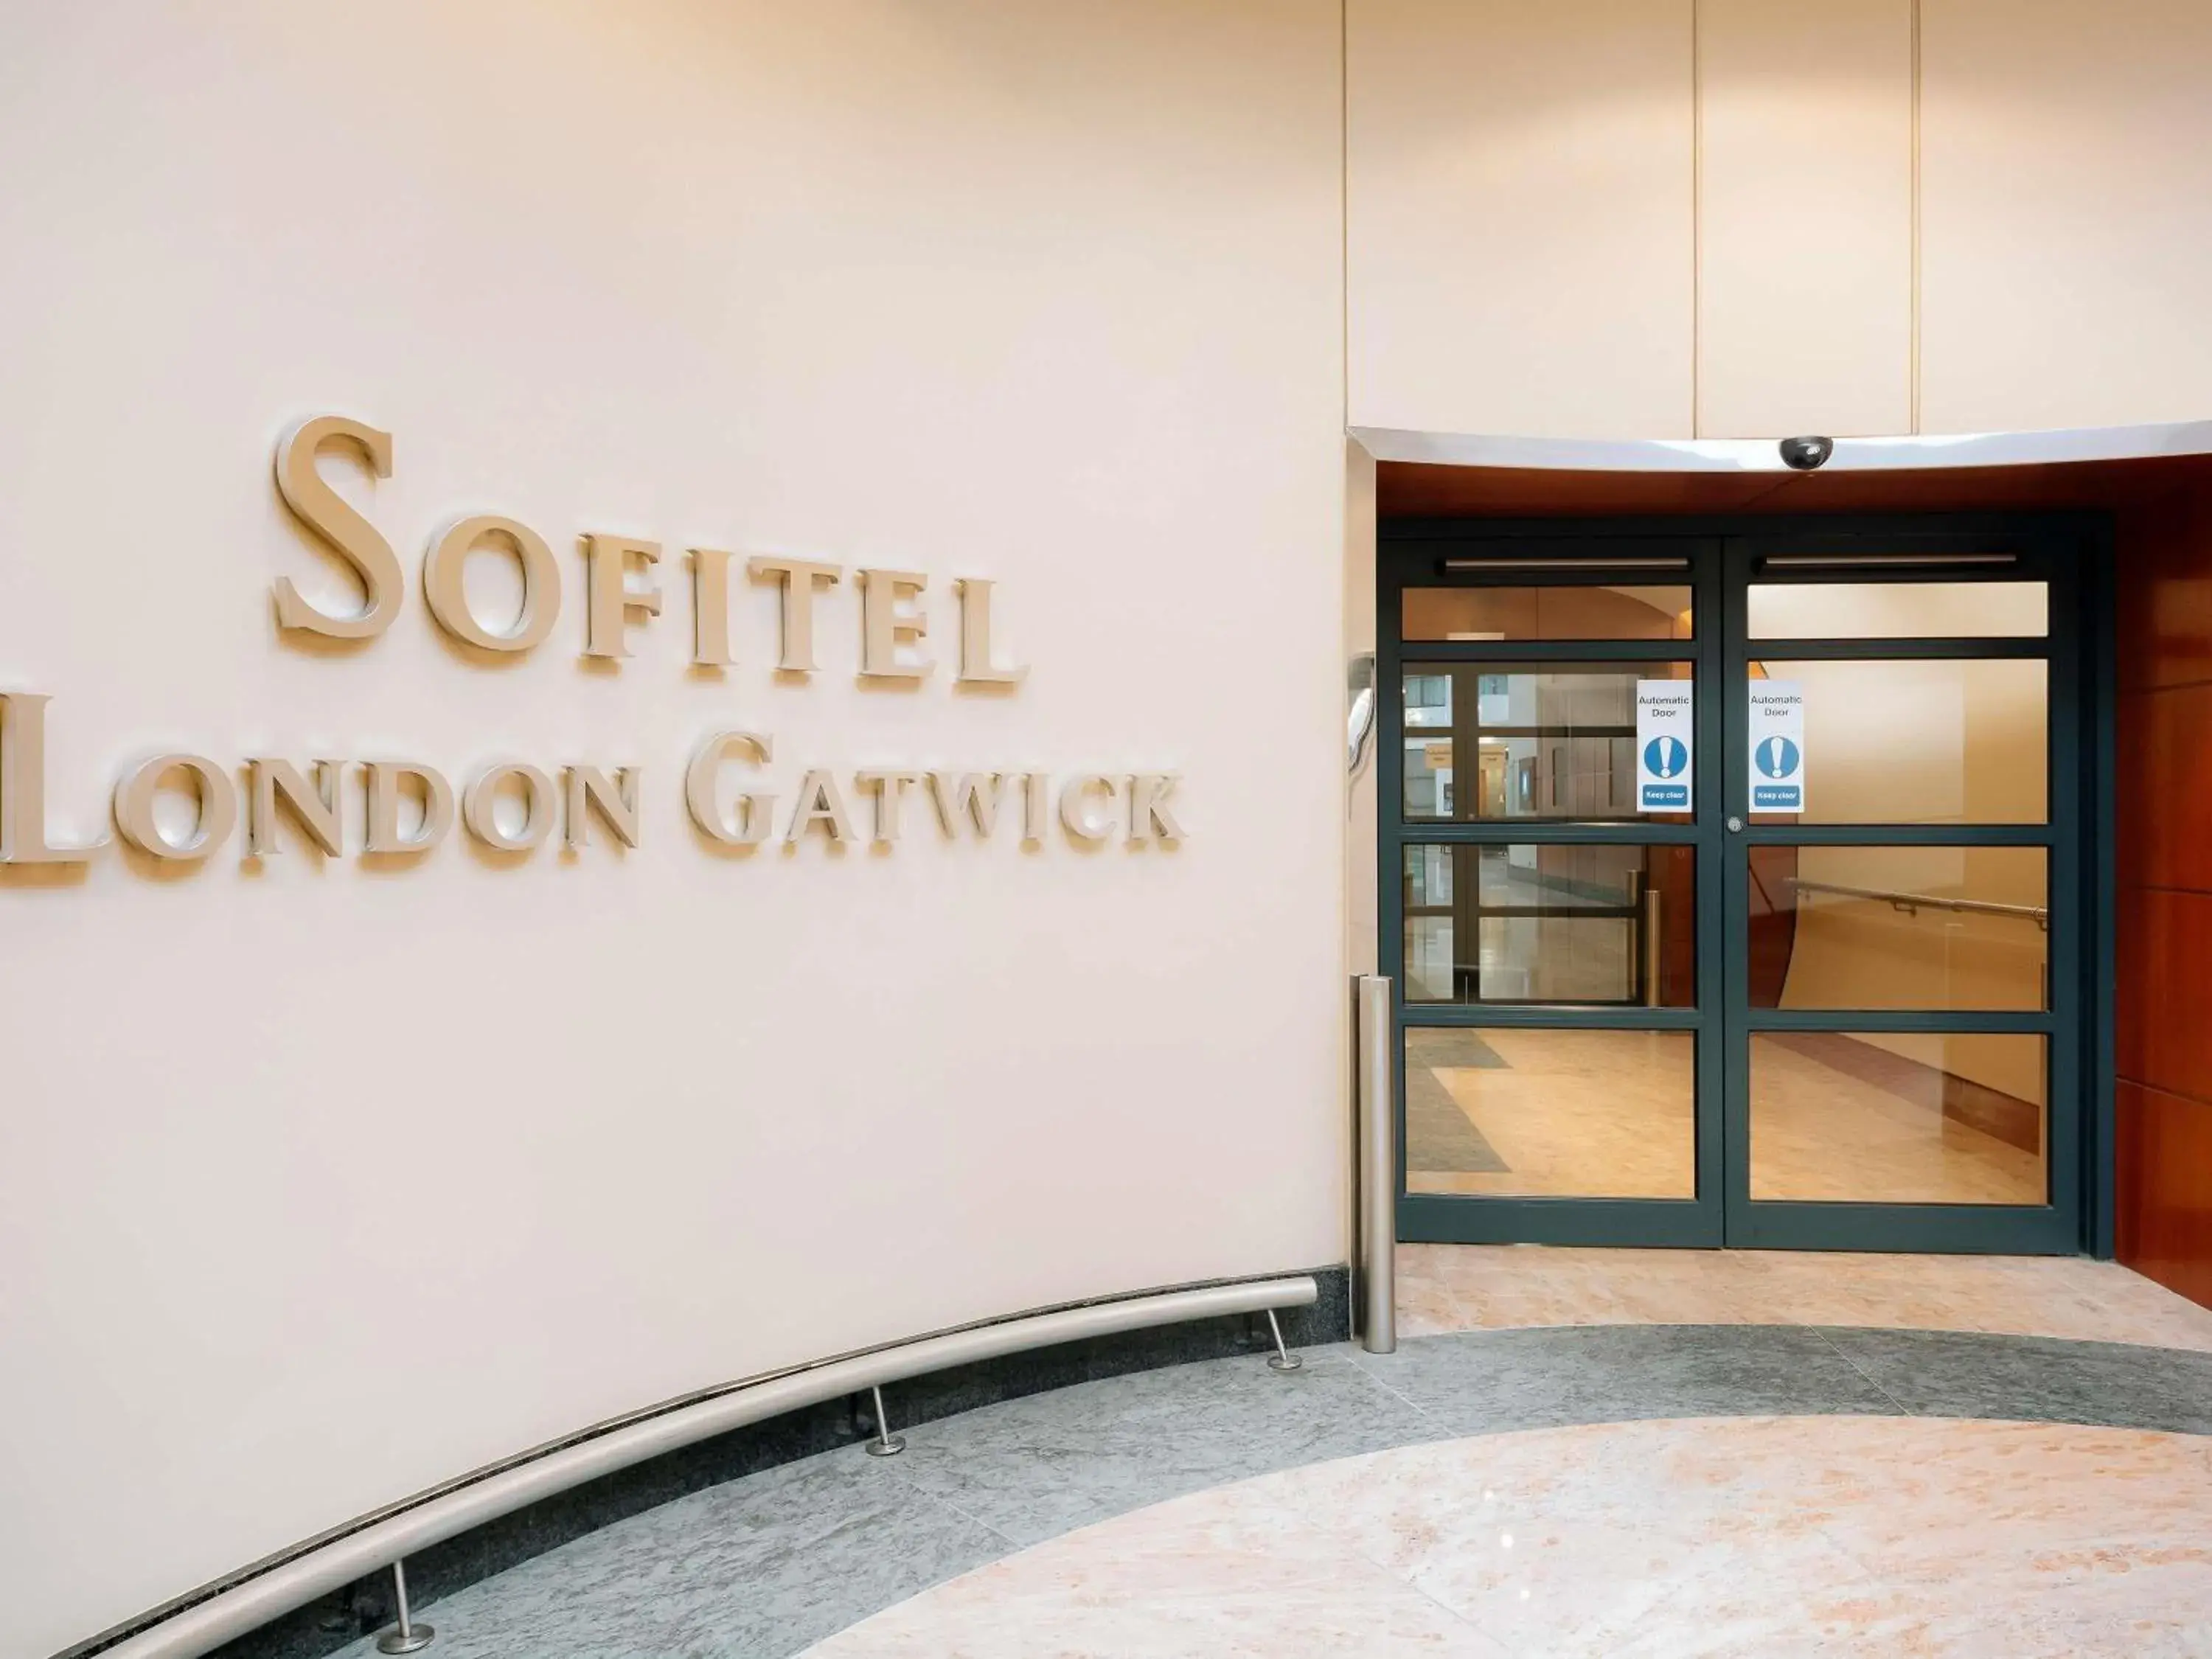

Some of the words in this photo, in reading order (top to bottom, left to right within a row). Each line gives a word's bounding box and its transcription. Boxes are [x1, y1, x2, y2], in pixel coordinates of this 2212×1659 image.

[272, 414, 1030, 683] SOFITEL
[1639, 696, 1689, 705] Automatic
[1751, 695, 1802, 705] Automatic
[1652, 709, 1677, 717] Door
[1764, 708, 1789, 717] Door
[0, 691, 642, 864] LONDON
[686, 730, 1189, 845] GATWICK
[1646, 790, 1664, 800] Keep
[1666, 790, 1685, 799] clear
[1757, 791, 1777, 801] Keep
[1778, 791, 1797, 800] clear
